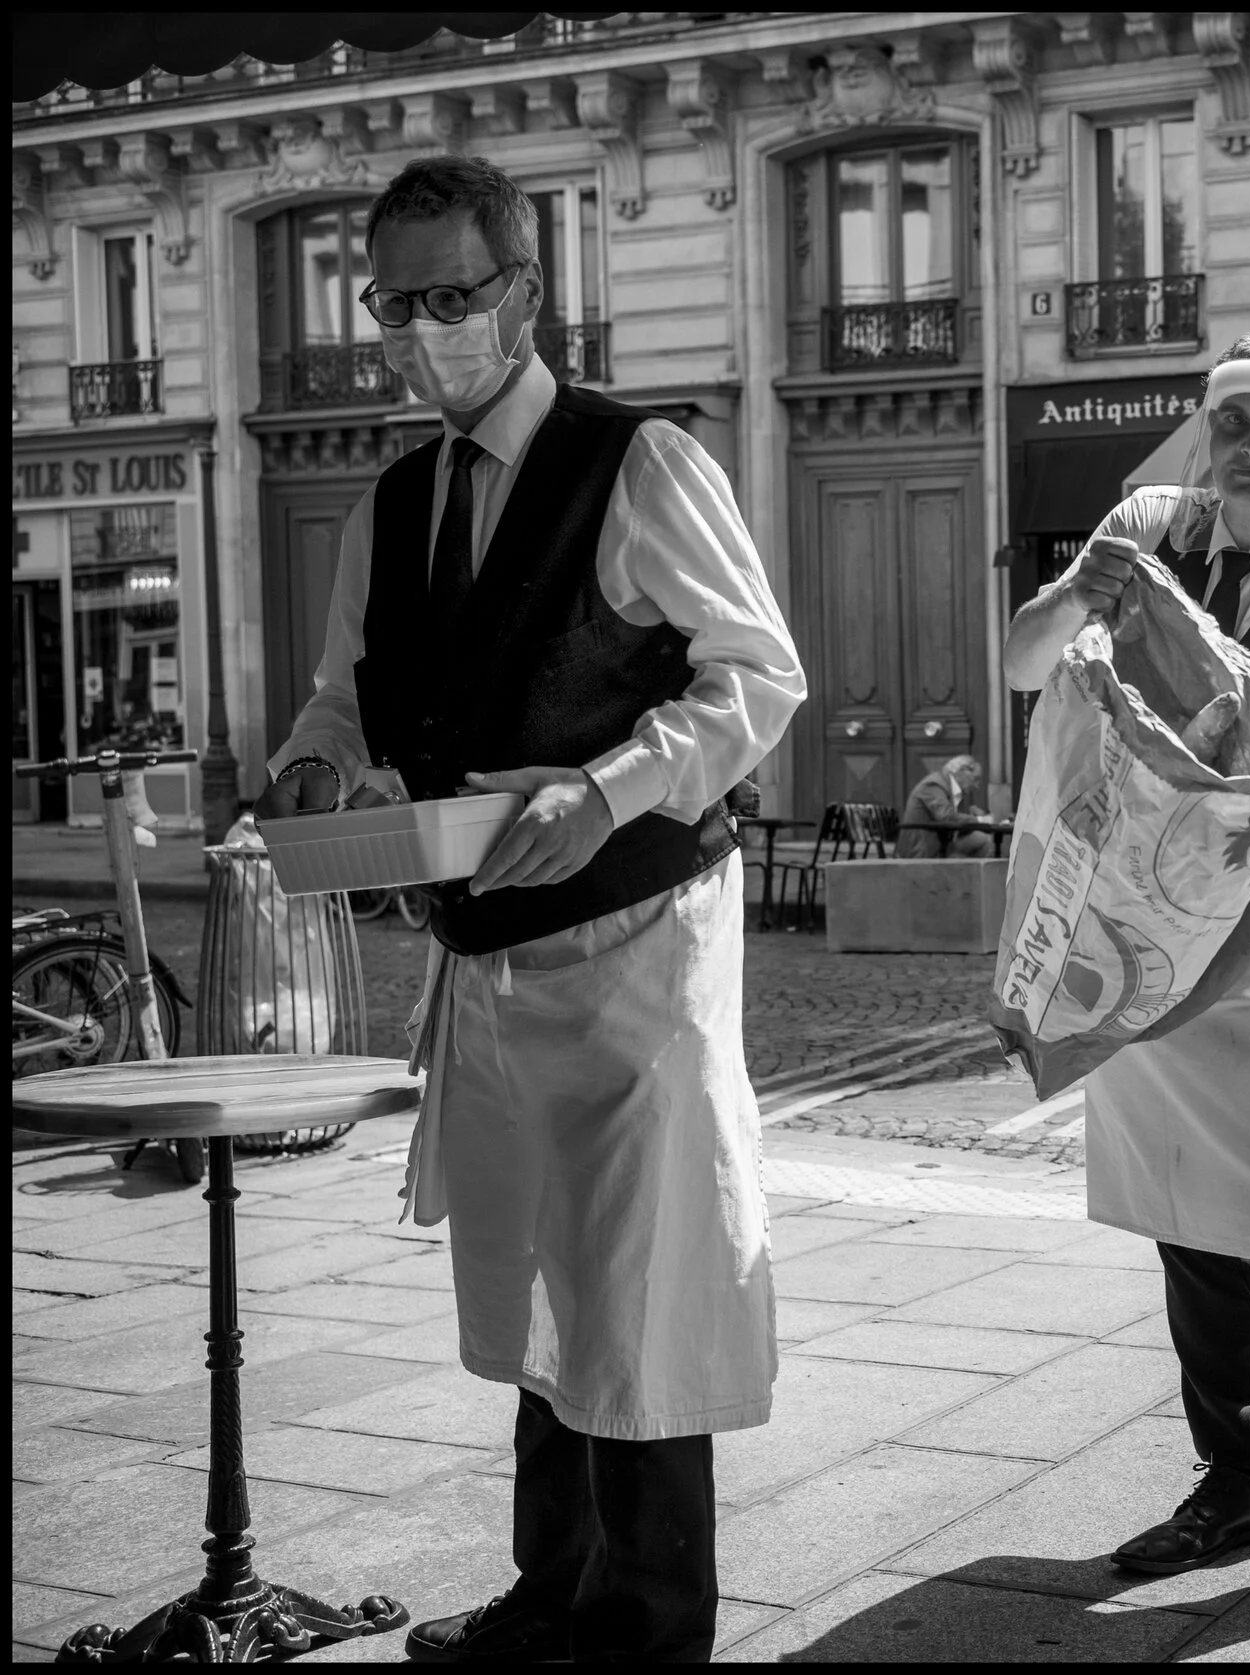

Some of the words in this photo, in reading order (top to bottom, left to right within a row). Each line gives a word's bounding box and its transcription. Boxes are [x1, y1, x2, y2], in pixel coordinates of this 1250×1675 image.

[1036, 293, 1048, 315] 6
[1038, 393, 1197, 426] Antiquités
[110, 452, 187, 493] LOUIS
